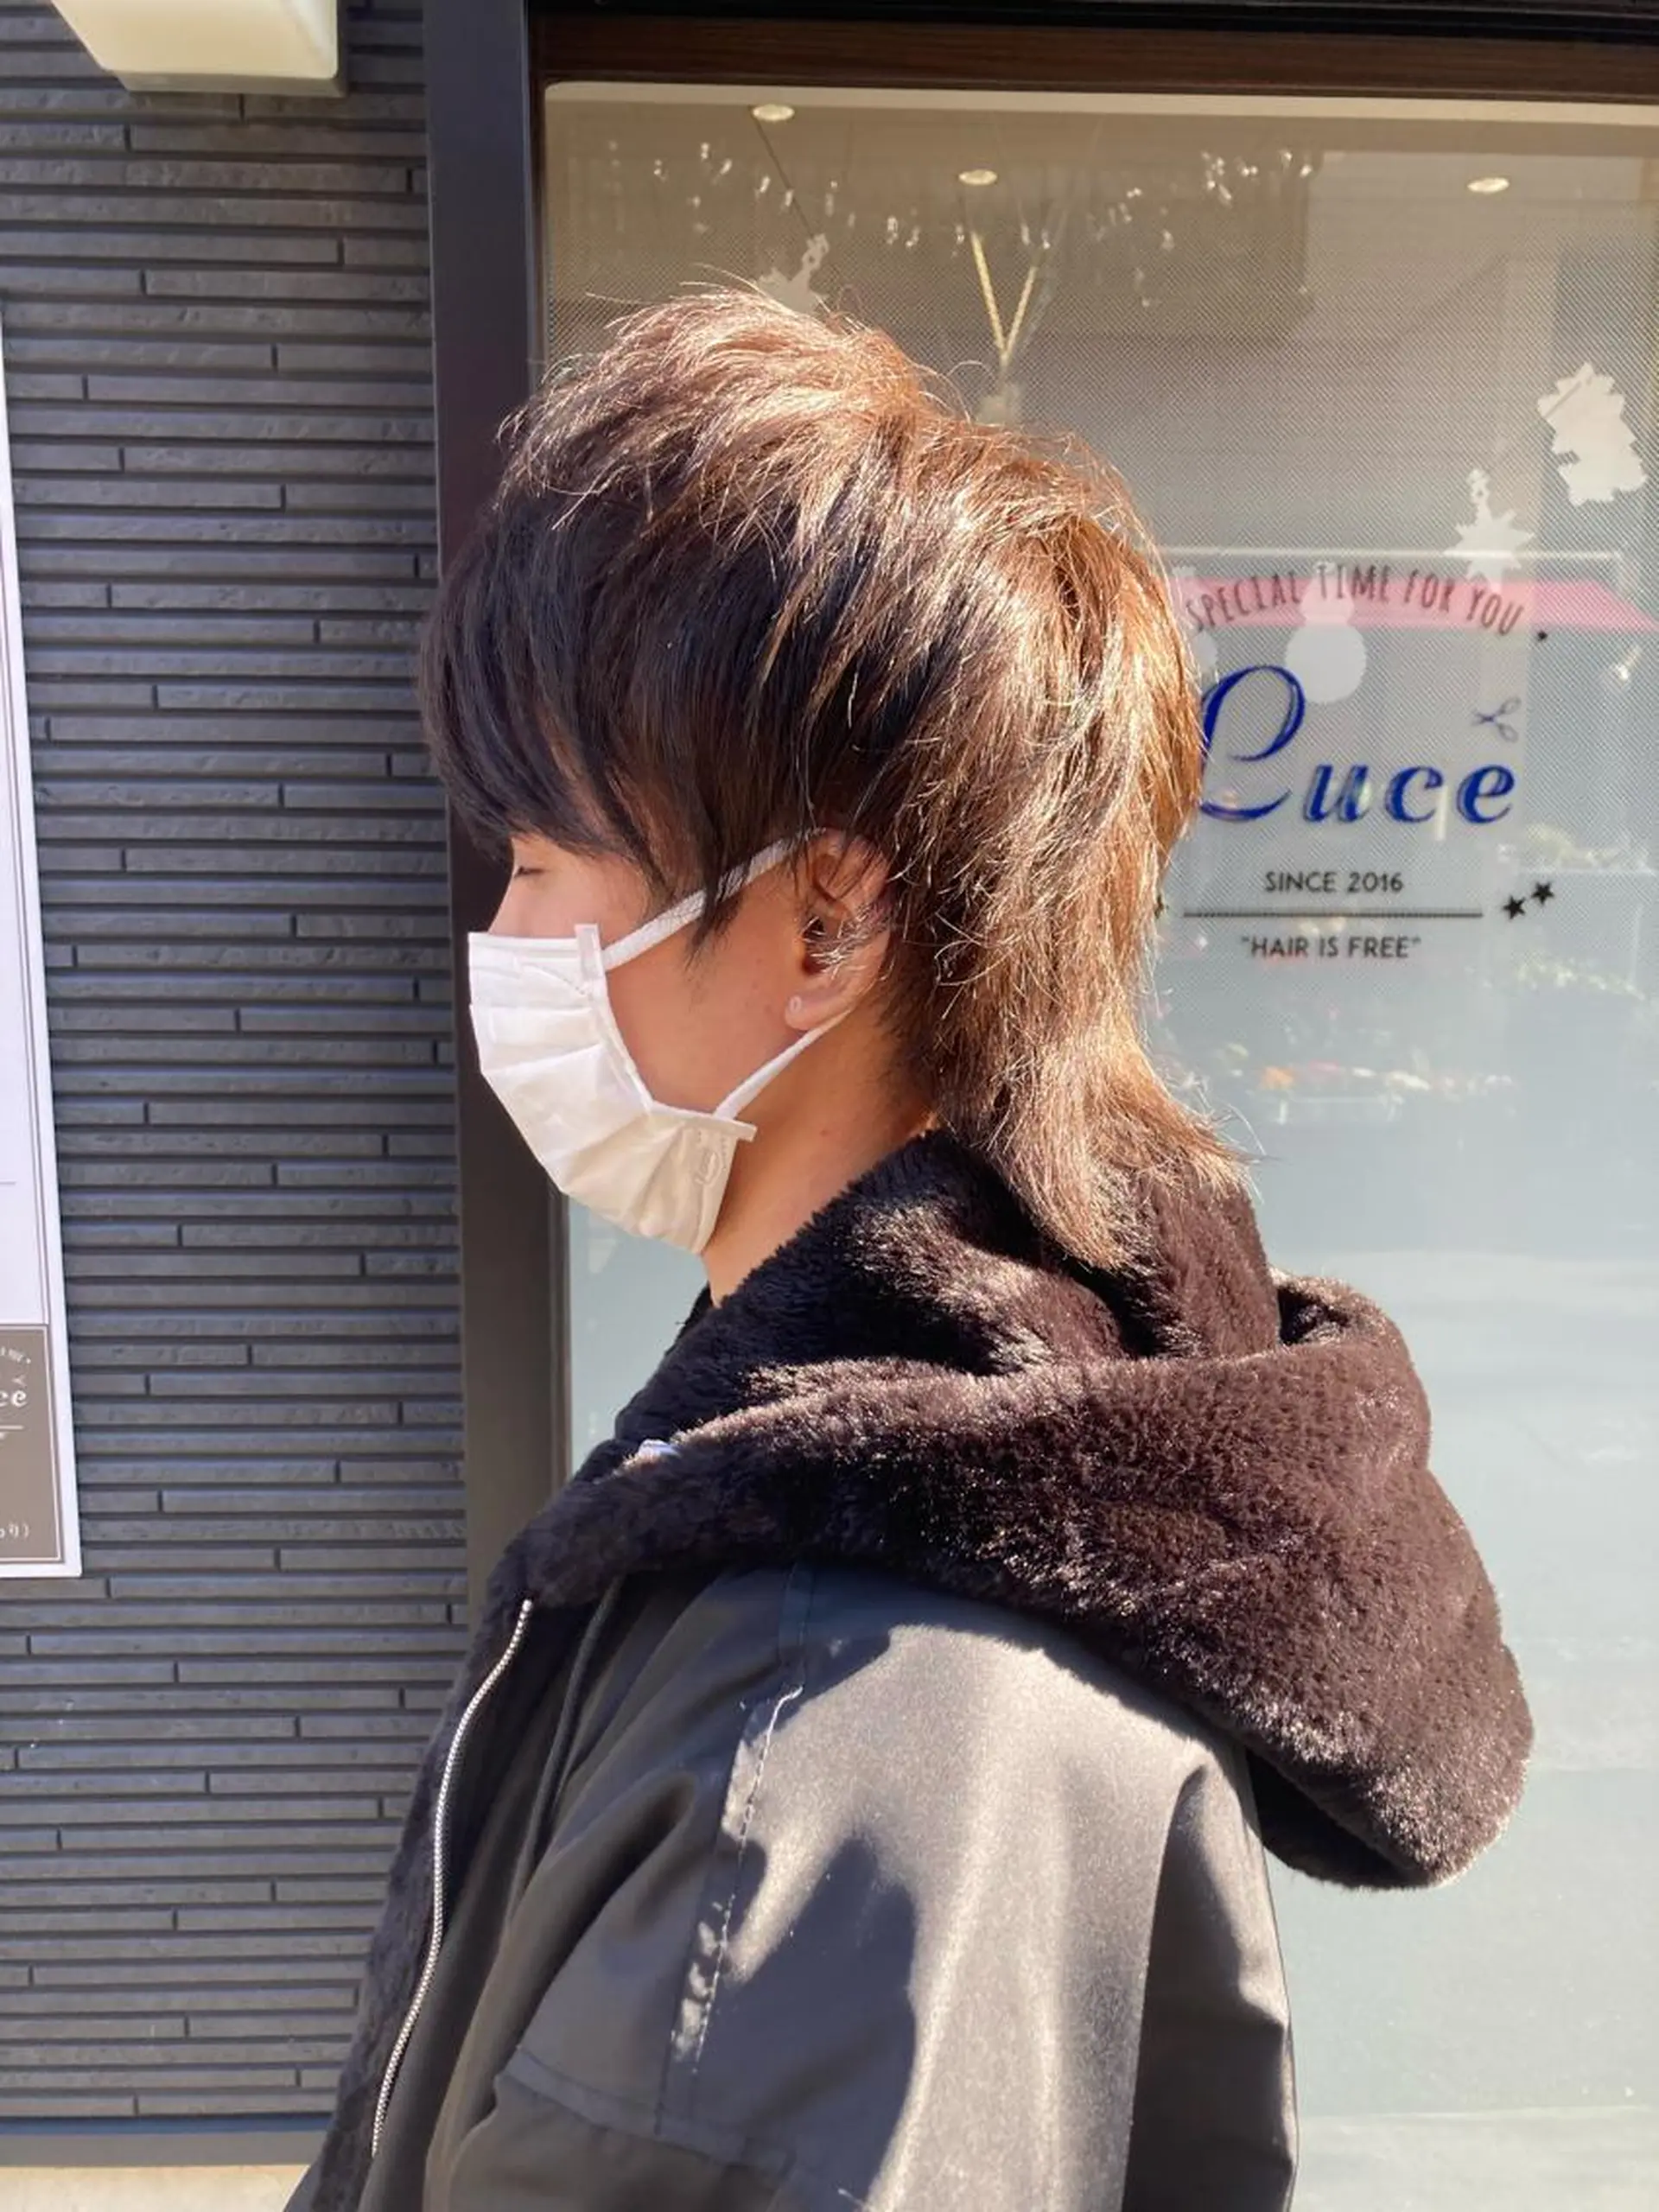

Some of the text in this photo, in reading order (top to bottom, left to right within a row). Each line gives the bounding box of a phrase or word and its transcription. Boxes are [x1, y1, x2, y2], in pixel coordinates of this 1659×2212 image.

[1185, 566, 1527, 637] SPECIAL TIME FOR YOU
[1199, 664, 1516, 823] Luce
[1264, 871, 1404, 893] SINCE 2016
[1319, 937, 1339, 958] IS
